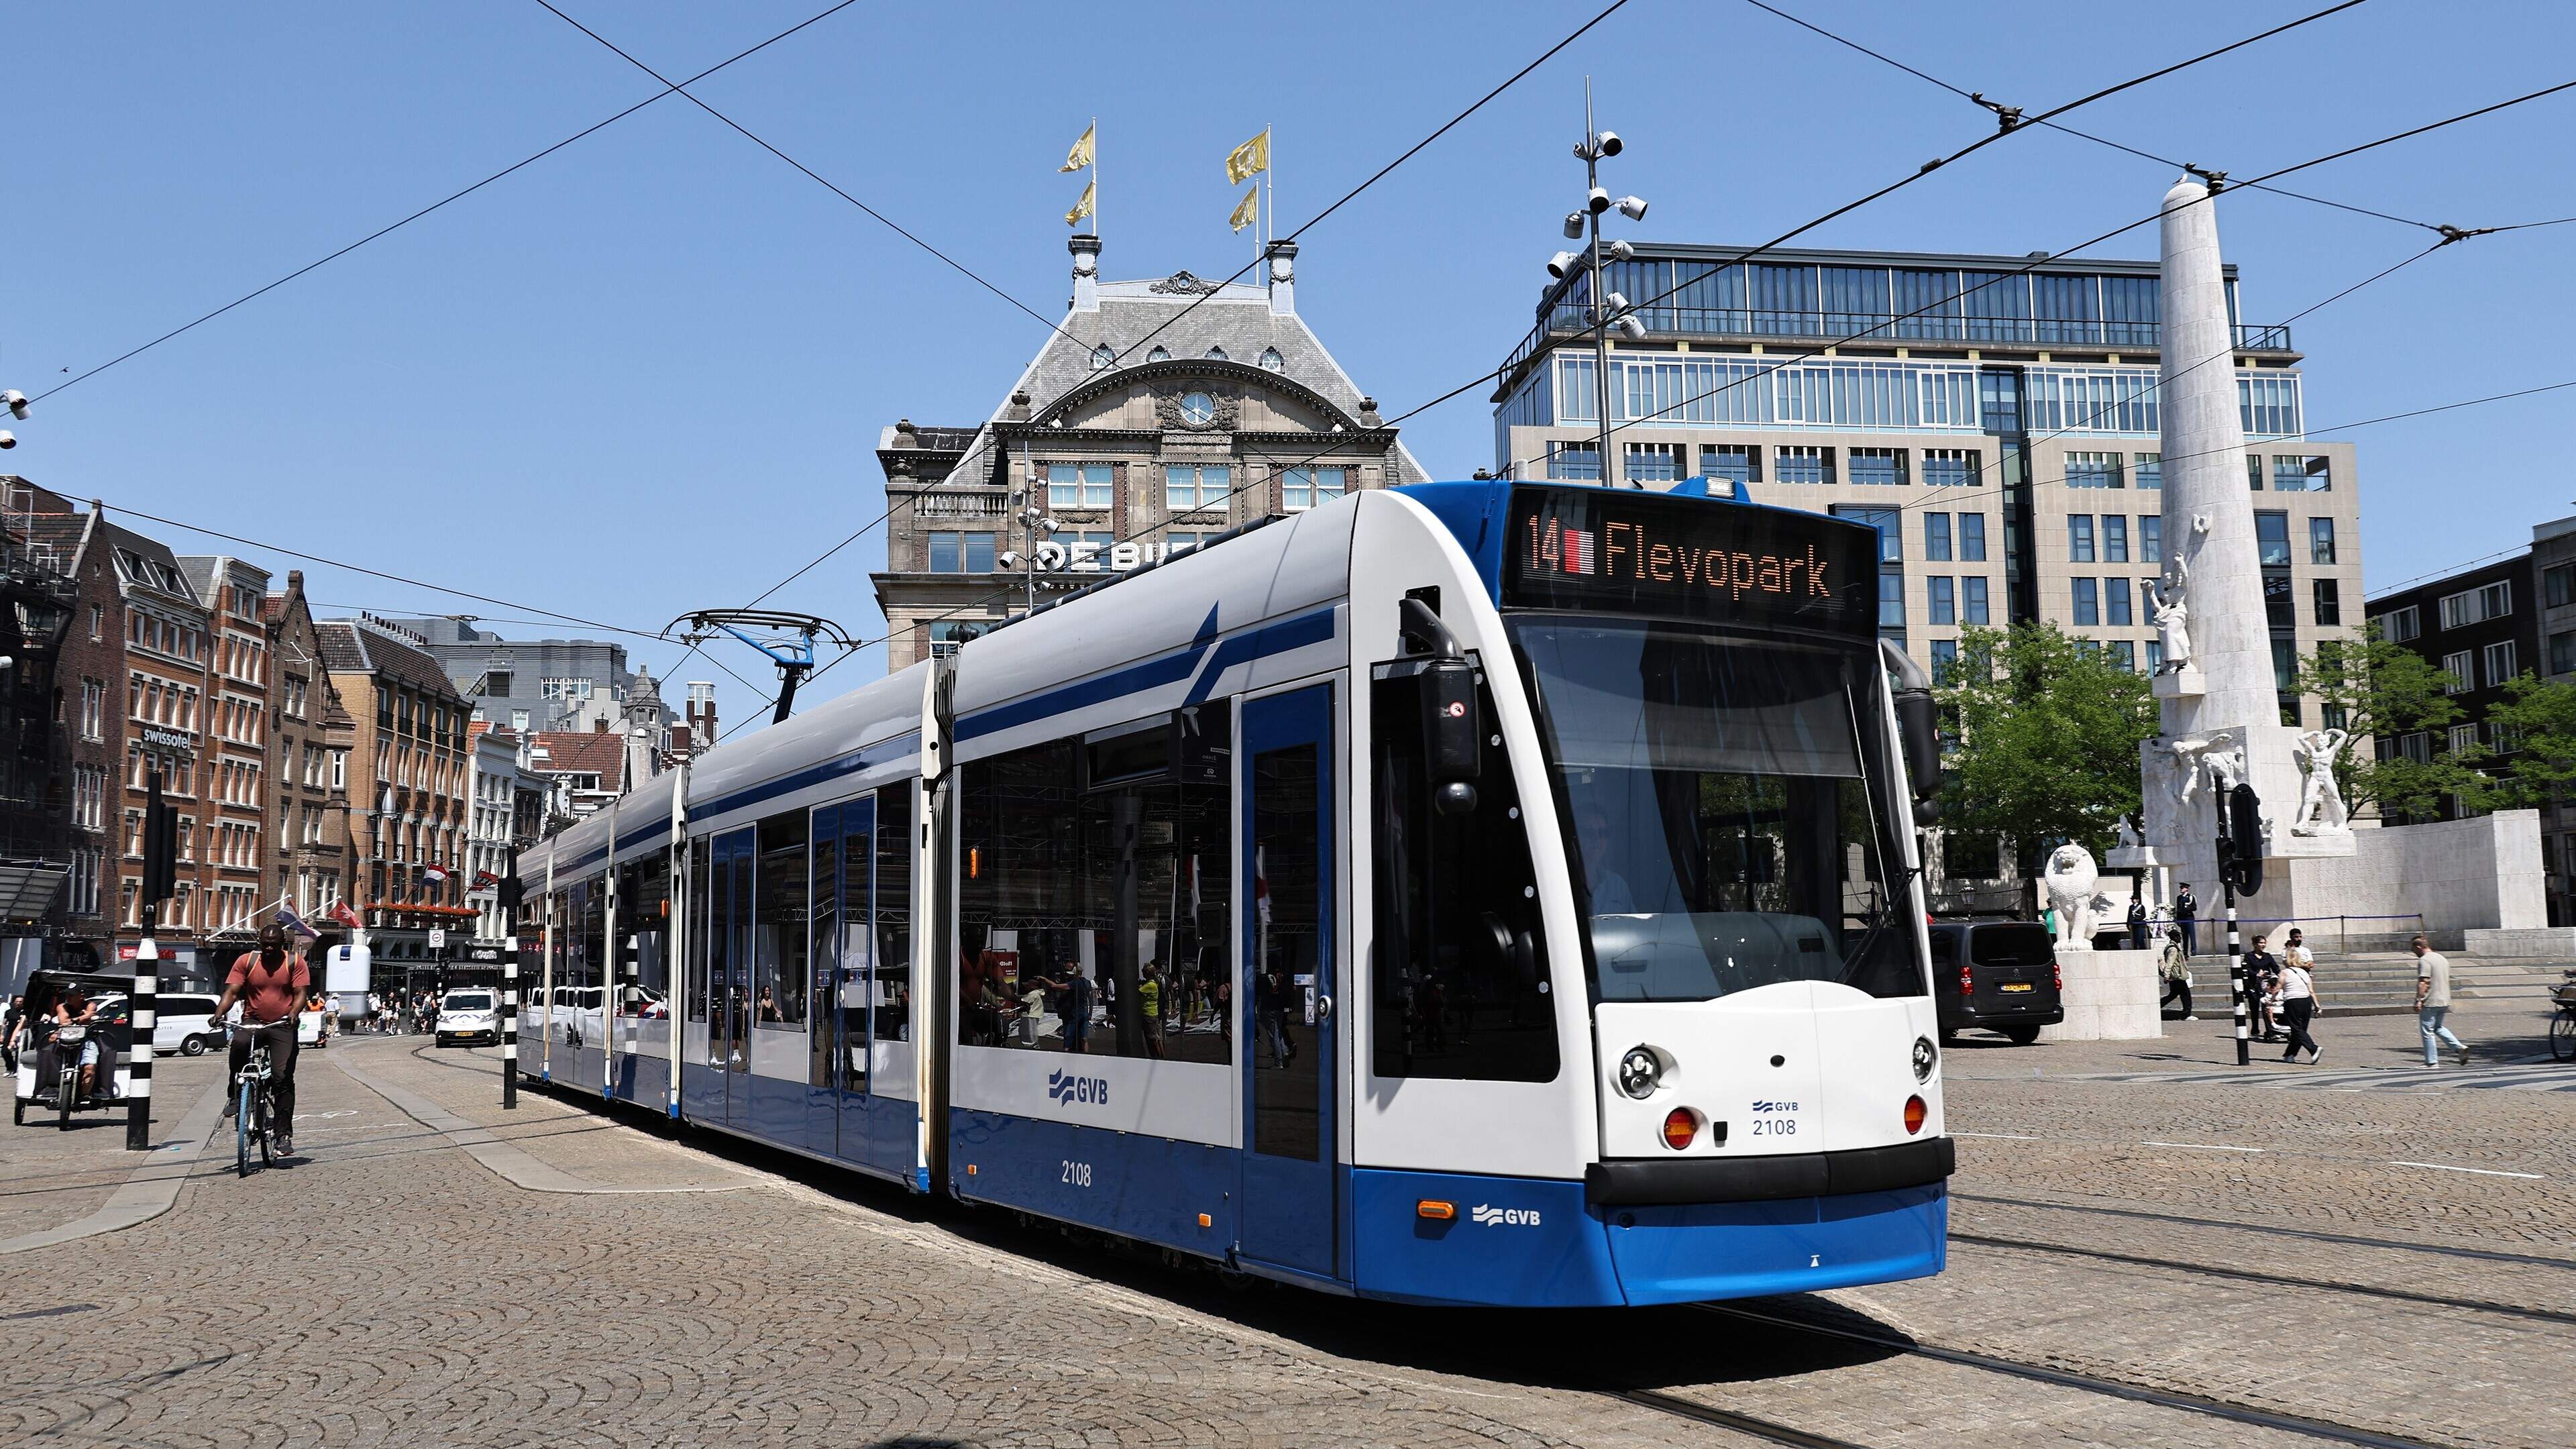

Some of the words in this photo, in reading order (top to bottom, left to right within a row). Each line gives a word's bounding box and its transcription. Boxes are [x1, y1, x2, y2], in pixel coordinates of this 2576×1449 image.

[1036, 541, 1101, 571] DE
[1529, 515, 1560, 571] 14
[1607, 521, 1831, 600] Flevopark
[144, 727, 191, 750] swissotel
[1077, 1077, 1108, 1105] GVB
[1775, 1102, 1799, 1112] GVB
[1753, 1119, 1796, 1135] 2108
[1062, 1159, 1091, 1187] 2108
[1505, 1209, 1541, 1226] GVB
